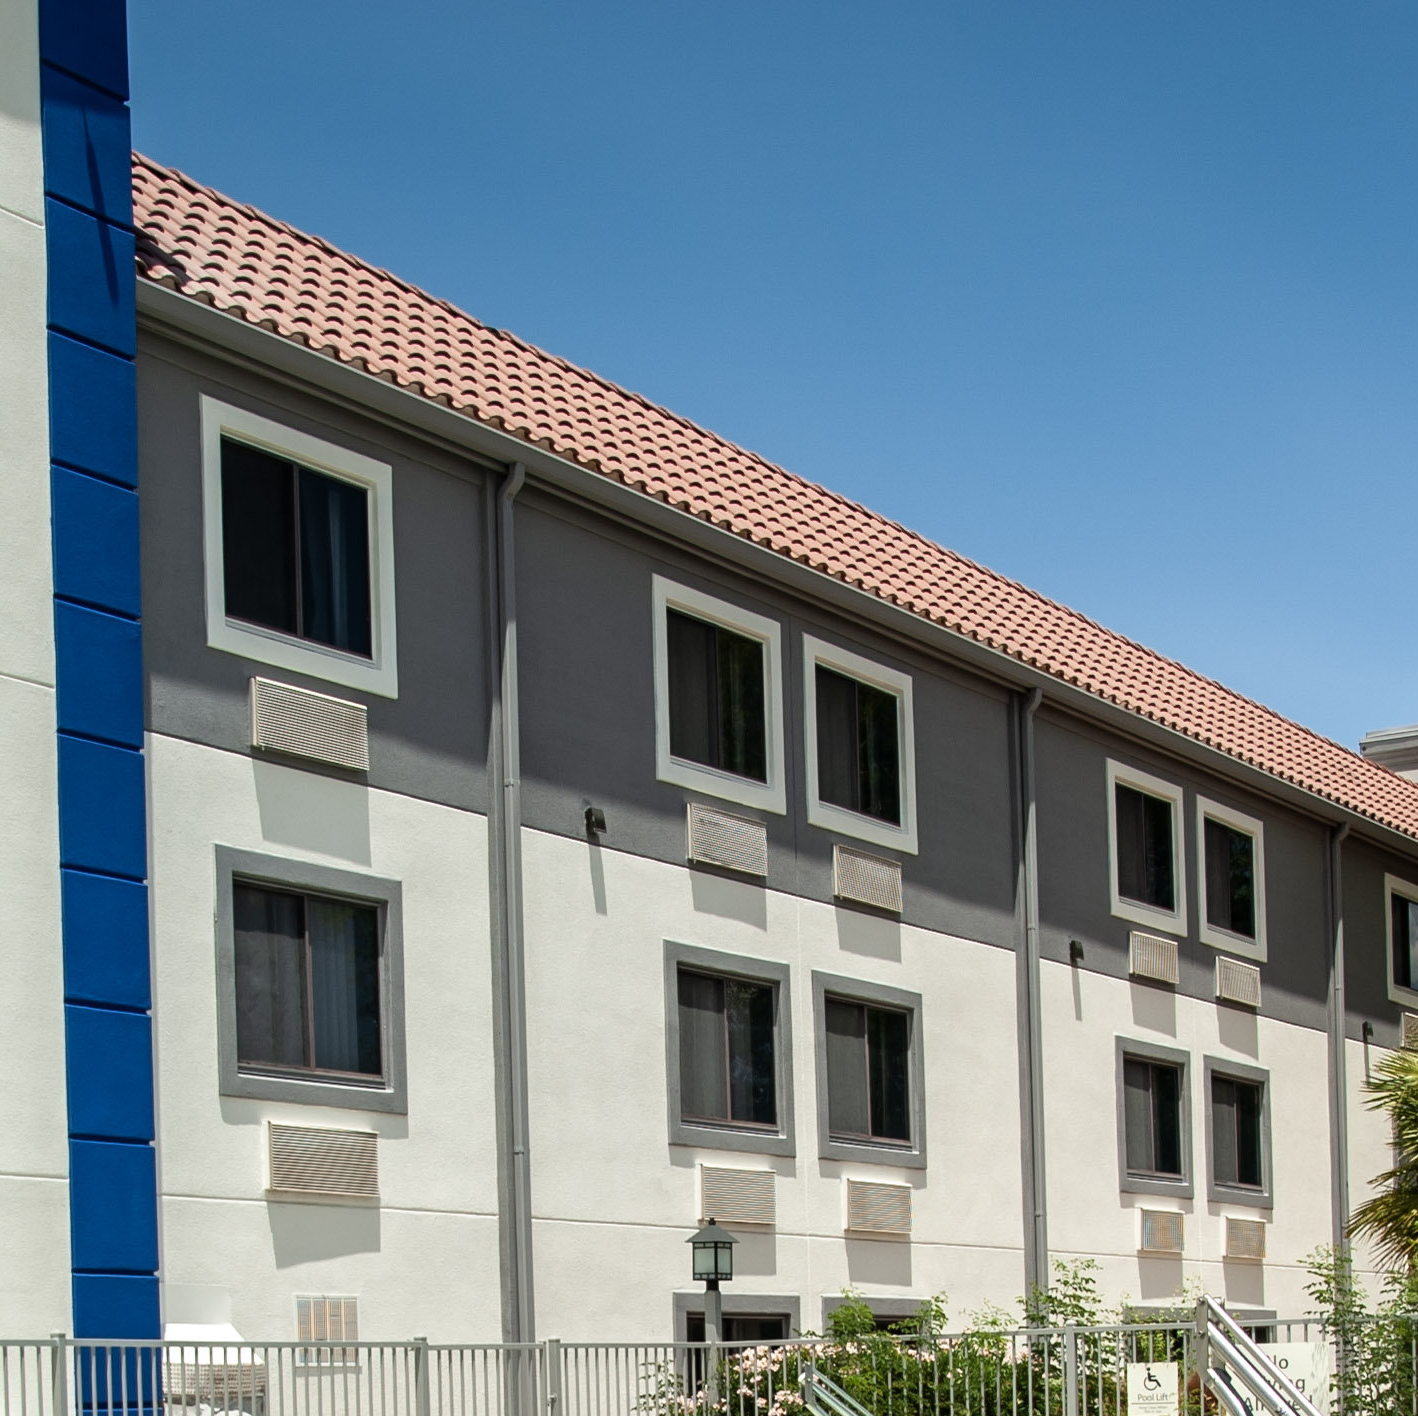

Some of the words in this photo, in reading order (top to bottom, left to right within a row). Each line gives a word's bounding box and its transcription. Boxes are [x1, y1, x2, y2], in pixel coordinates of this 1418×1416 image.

[1137, 1393, 1155, 1401] Pool
[1156, 1393, 1169, 1401] Lift
[1242, 1395, 1313, 1411] Alle
